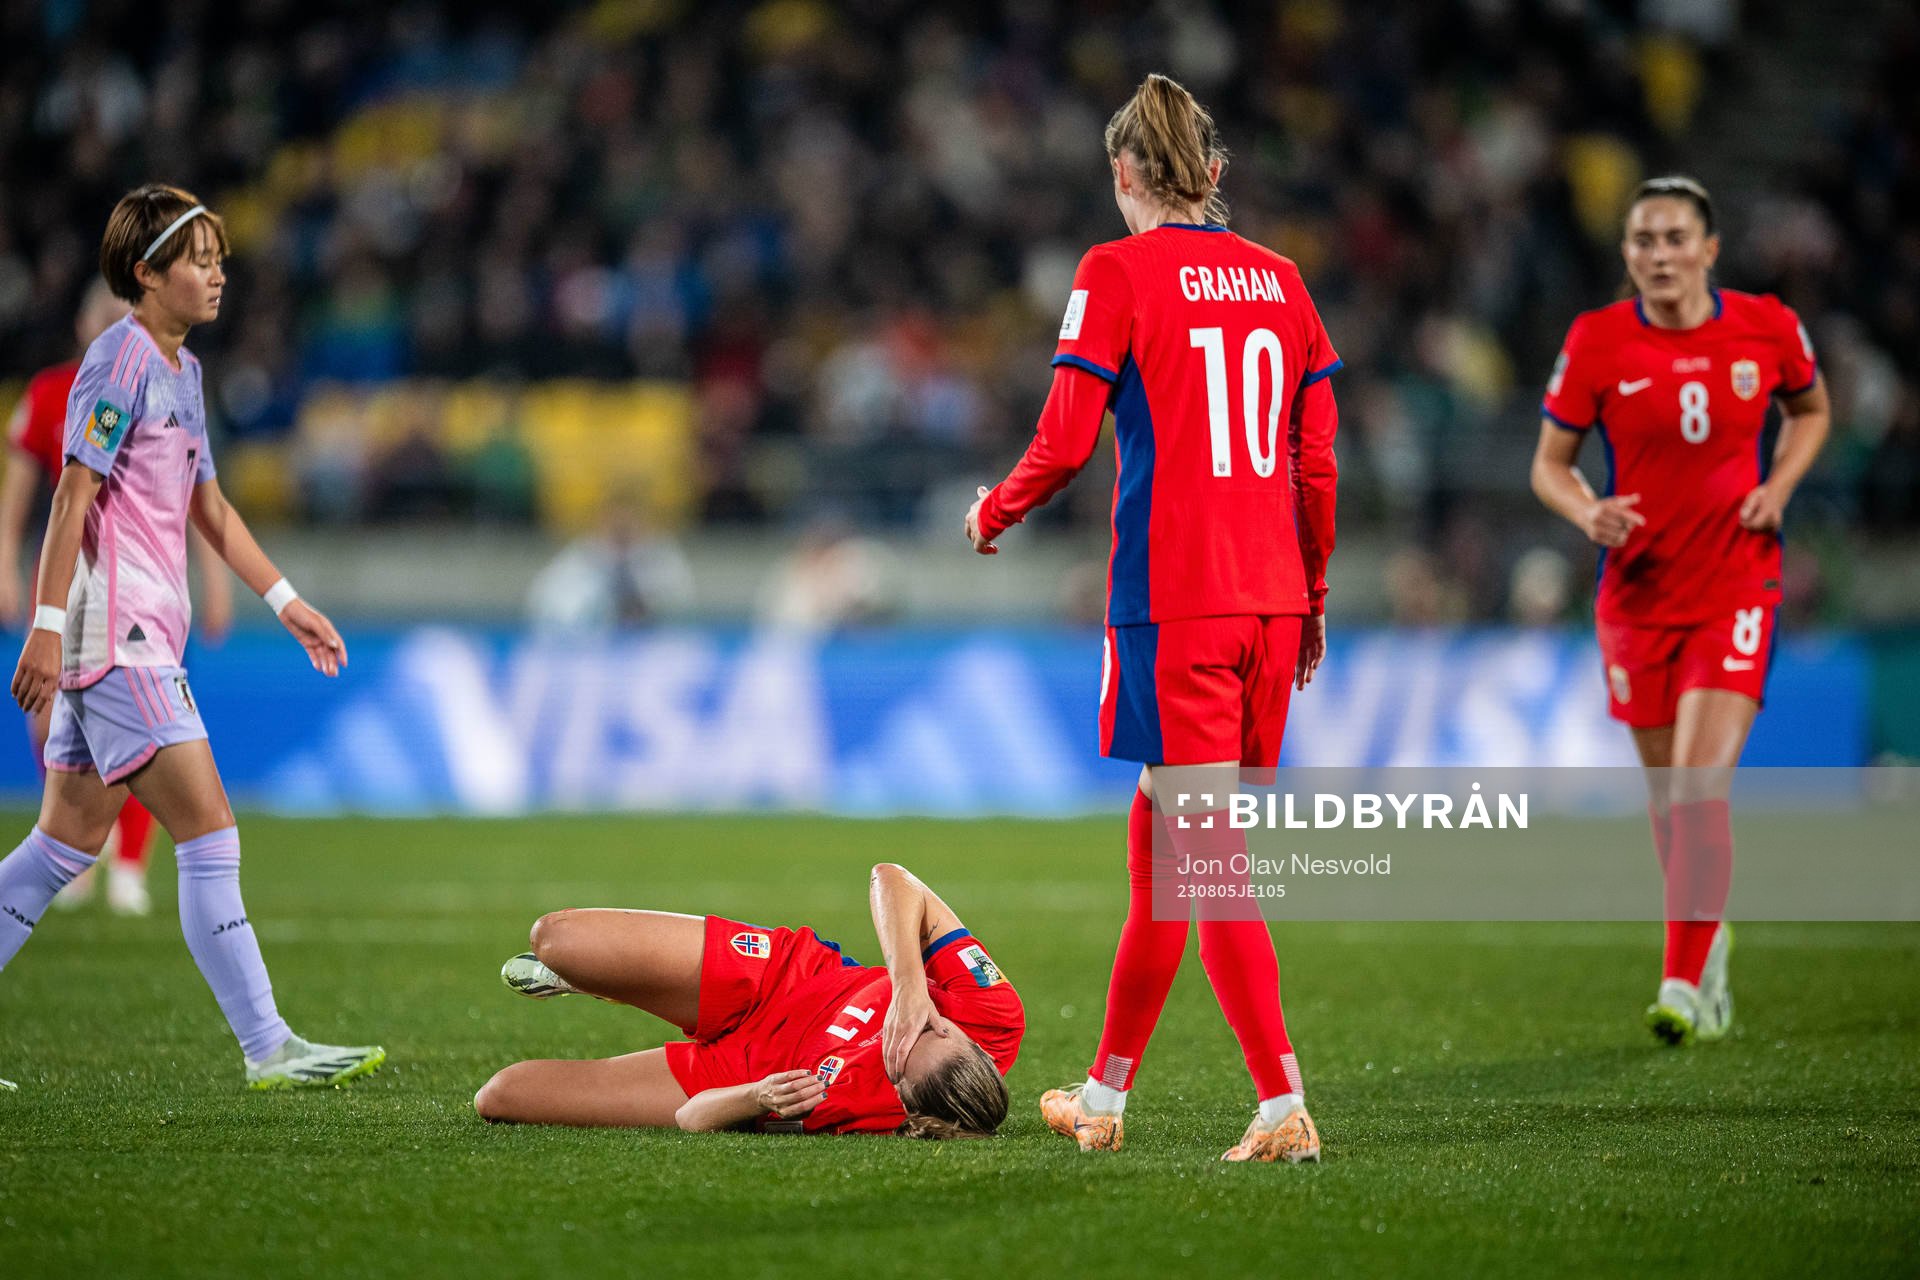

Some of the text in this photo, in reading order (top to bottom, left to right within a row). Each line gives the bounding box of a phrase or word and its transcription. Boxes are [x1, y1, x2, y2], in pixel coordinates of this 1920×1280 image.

[1179, 266, 1286, 304] GRAHAM
[1189, 327, 1284, 478] 10
[1679, 381, 1710, 443] 8
[1732, 606, 1763, 656] 8
